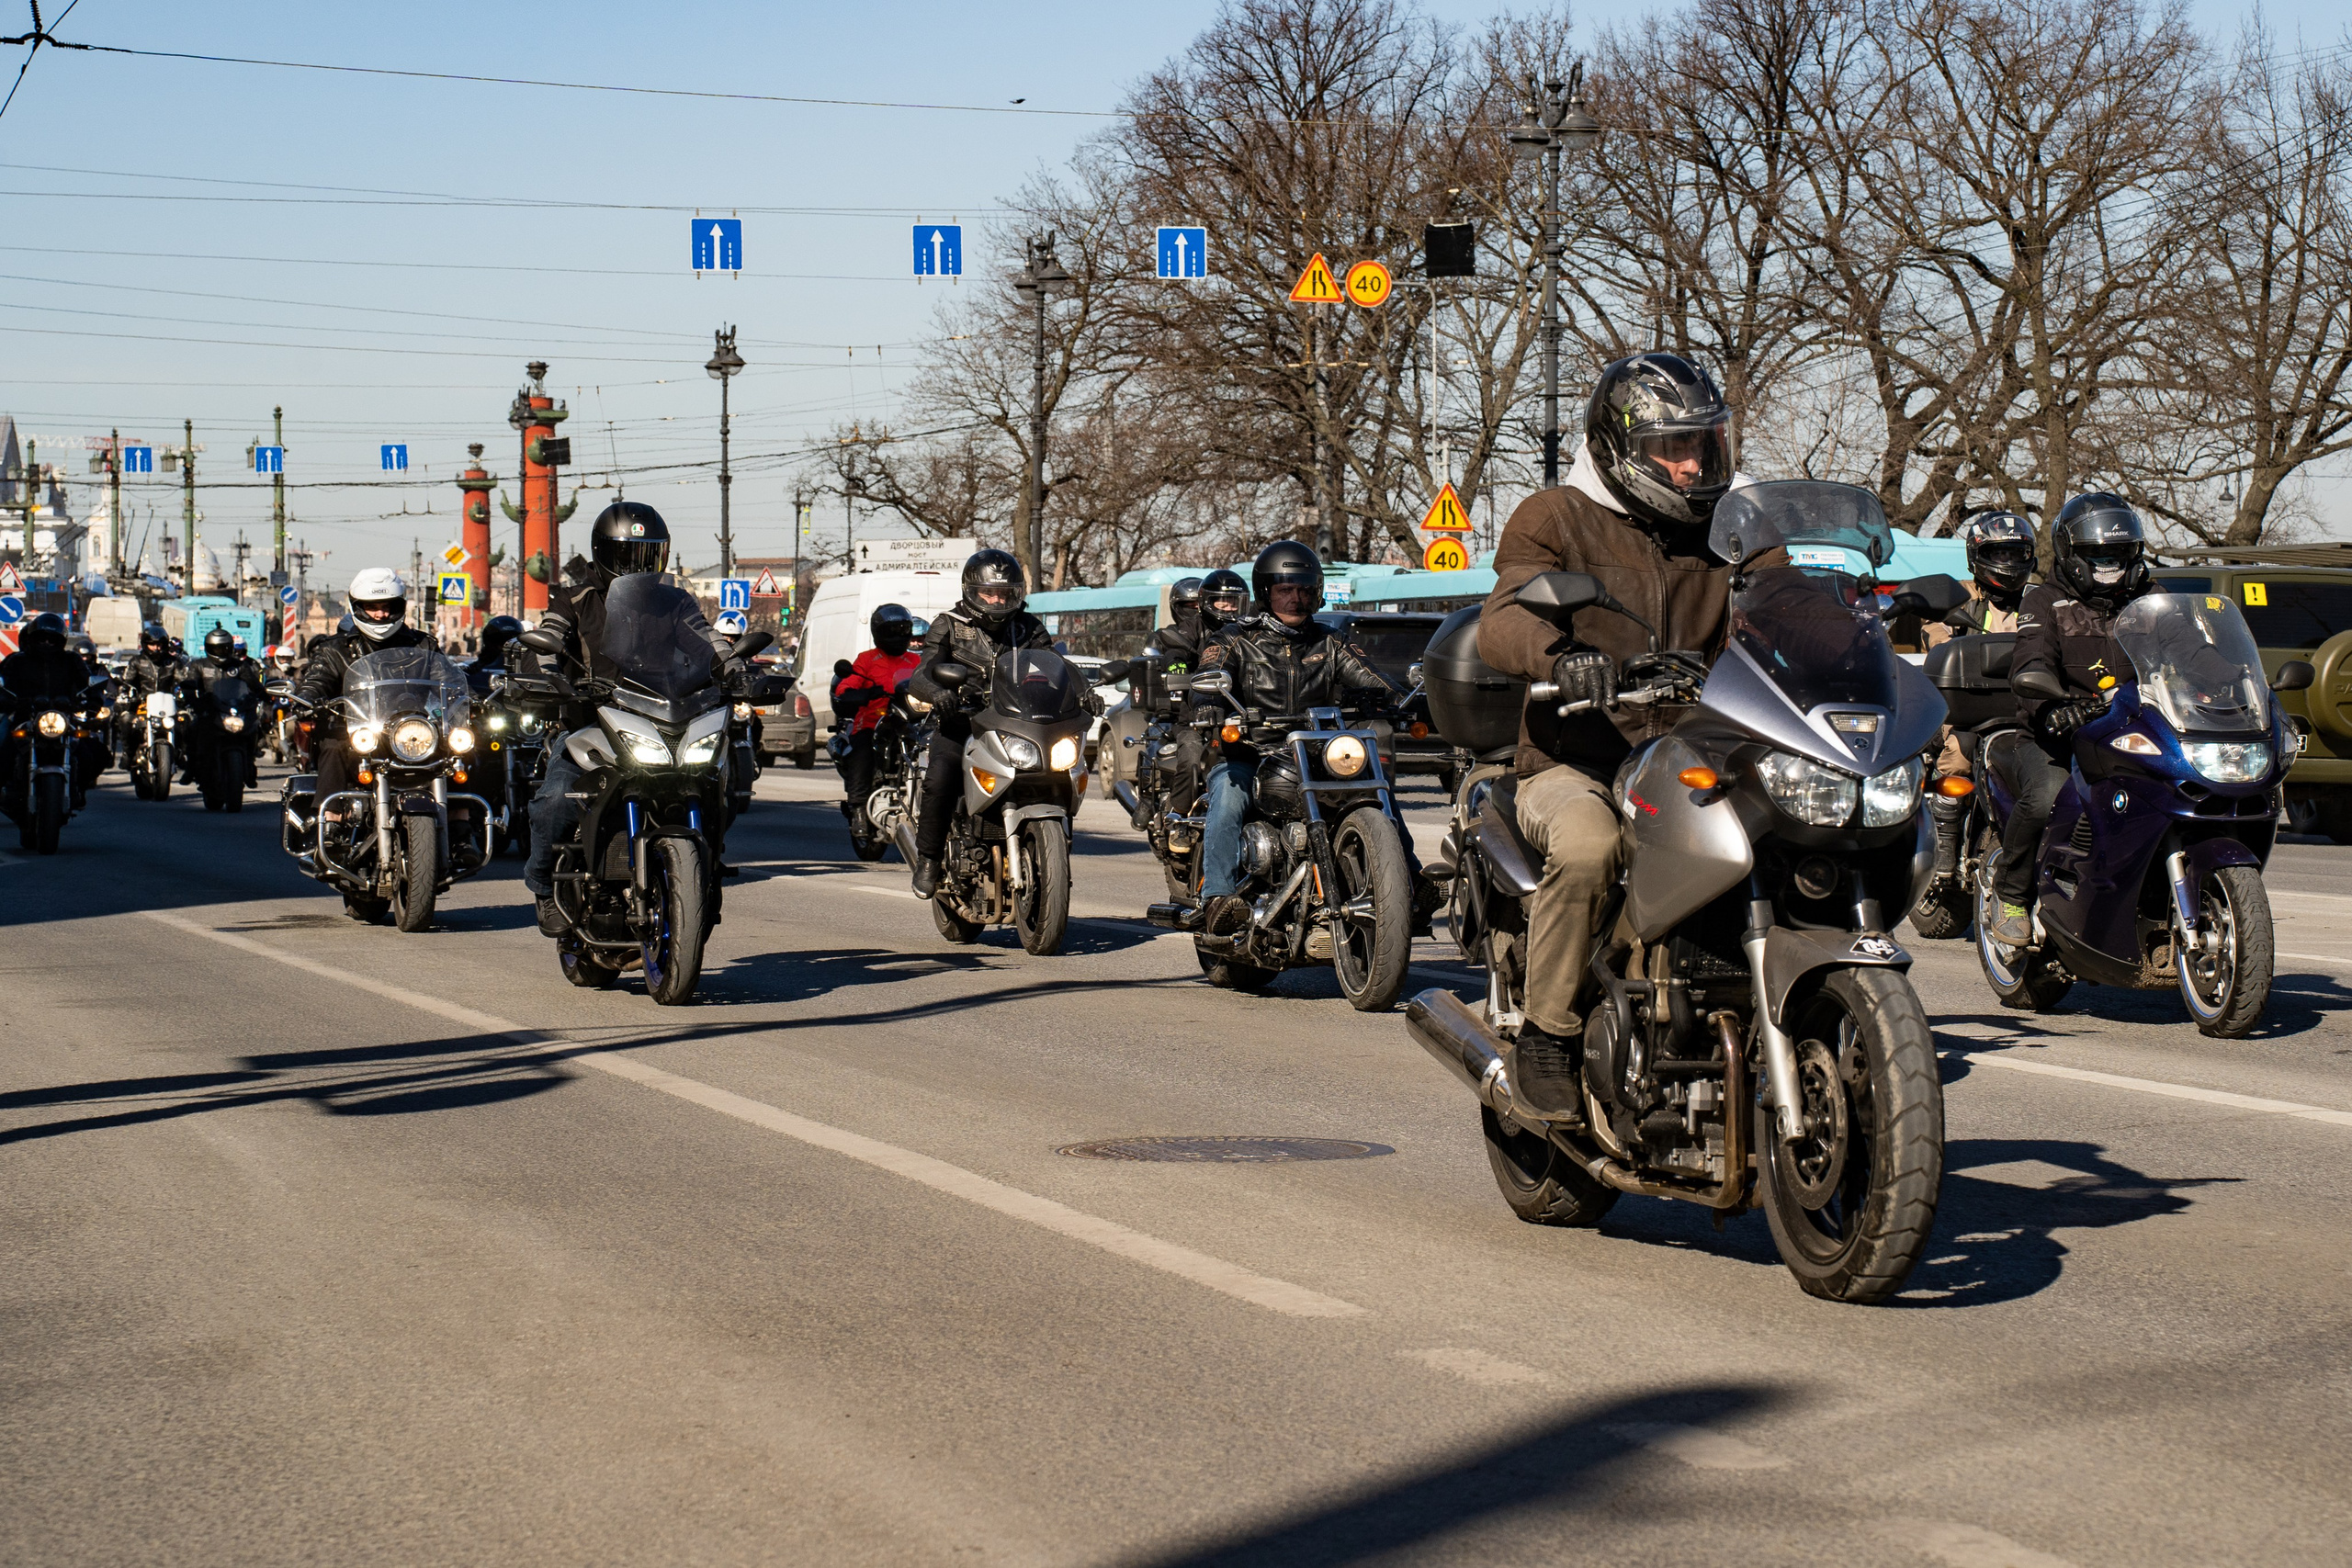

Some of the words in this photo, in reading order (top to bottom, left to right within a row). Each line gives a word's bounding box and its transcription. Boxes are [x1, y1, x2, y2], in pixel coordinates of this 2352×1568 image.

[1355, 275, 1381, 293] 40
[1678, 404, 1718, 419] LS2
[890, 539, 944, 550] ДВОРЦОВЫЙ
[876, 561, 959, 570] АДМИРАЛТЕЙСКАЯ
[1434, 550, 1459, 569] 40
[1627, 788, 1659, 817] TDM
